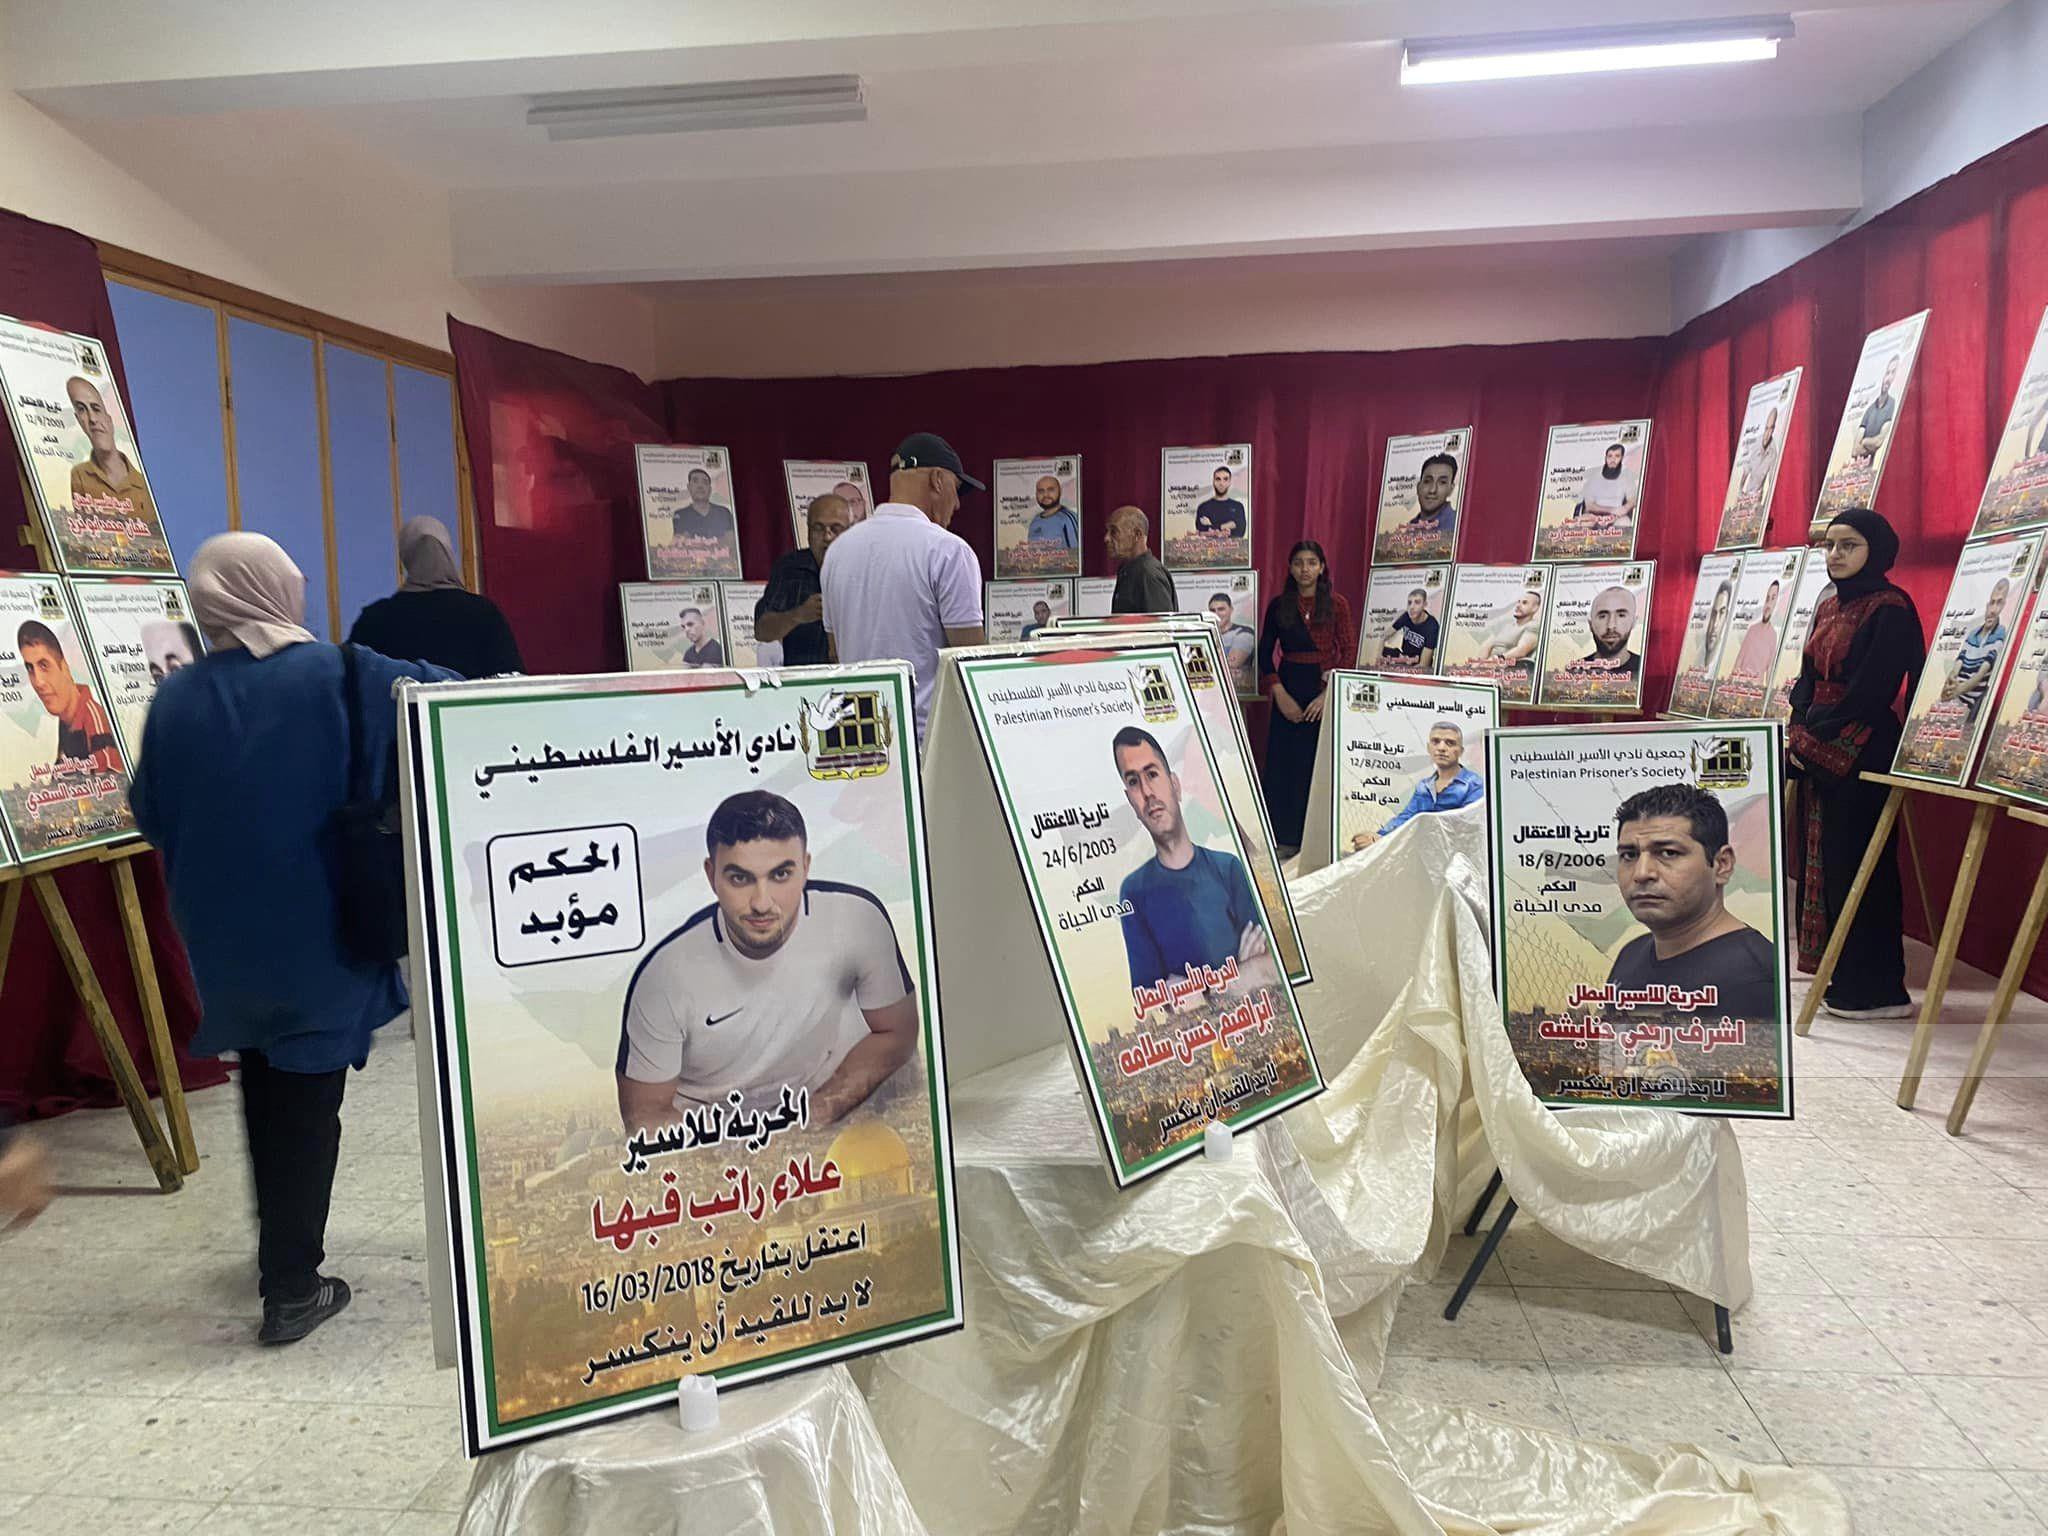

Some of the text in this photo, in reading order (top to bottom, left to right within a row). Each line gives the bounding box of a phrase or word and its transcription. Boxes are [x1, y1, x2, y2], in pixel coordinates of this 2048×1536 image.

[987, 679, 1128, 705] جمعية نادي الأسير الفلسطيني
[994, 699, 1135, 726] Palestinian Prisoner's Society
[1386, 696, 1486, 719] نادي الأسير الفلسطيني
[474, 717, 797, 801] نادي الأسير الفلسطيني
[1346, 740, 1405, 756] تاريخ الاعتقال
[1509, 747, 1686, 765] جمعية نادي الأسير الفلسطيني
[1349, 757, 1402, 770] 12/8/2004
[1510, 766, 1687, 781] Palestinian Prisoner's Society
[1351, 792, 1401, 806] مدى الحياة
[1030, 801, 1110, 840] تاريخ الاعتقال
[1513, 824, 1610, 844] تاريخ الاعتقال
[1042, 837, 1117, 869] 24/6/2003
[1519, 852, 1606, 869] 18/8/2006
[508, 840, 621, 894] الحكم
[519, 893, 619, 945] مؤبد
[1058, 898, 1135, 934] مدى الحياة
[1513, 899, 1602, 915] مدى الحياة
[1133, 956, 1239, 1021] الحرية للأسير البطل
[1568, 983, 1616, 1009] البطل
[1668, 985, 1718, 1011] الحرية
[1118, 988, 1275, 1077] ابراهيم حسن سلامه
[1538, 1012, 1745, 1057] اشرف ربحي حنايشه
[1251, 1072, 1271, 1096] بد
[1266, 1061, 1279, 1083] لا
[1218, 1075, 1252, 1112] للقيد
[1555, 1074, 1613, 1099] ينكسر
[1640, 1076, 1687, 1099] للقيد
[1688, 1079, 1711, 1103] بد
[1712, 1078, 1727, 1096] لا
[621, 1082, 810, 1174] الحرية للاسير
[1158, 1097, 1204, 1144] ينكسر
[590, 1152, 842, 1251] علاء راتب قبها
[580, 1221, 868, 1315] اعتقل بتاريخ 16/03/2018
[580, 1277, 873, 1387] لا بد للقيد أن ينكسر
